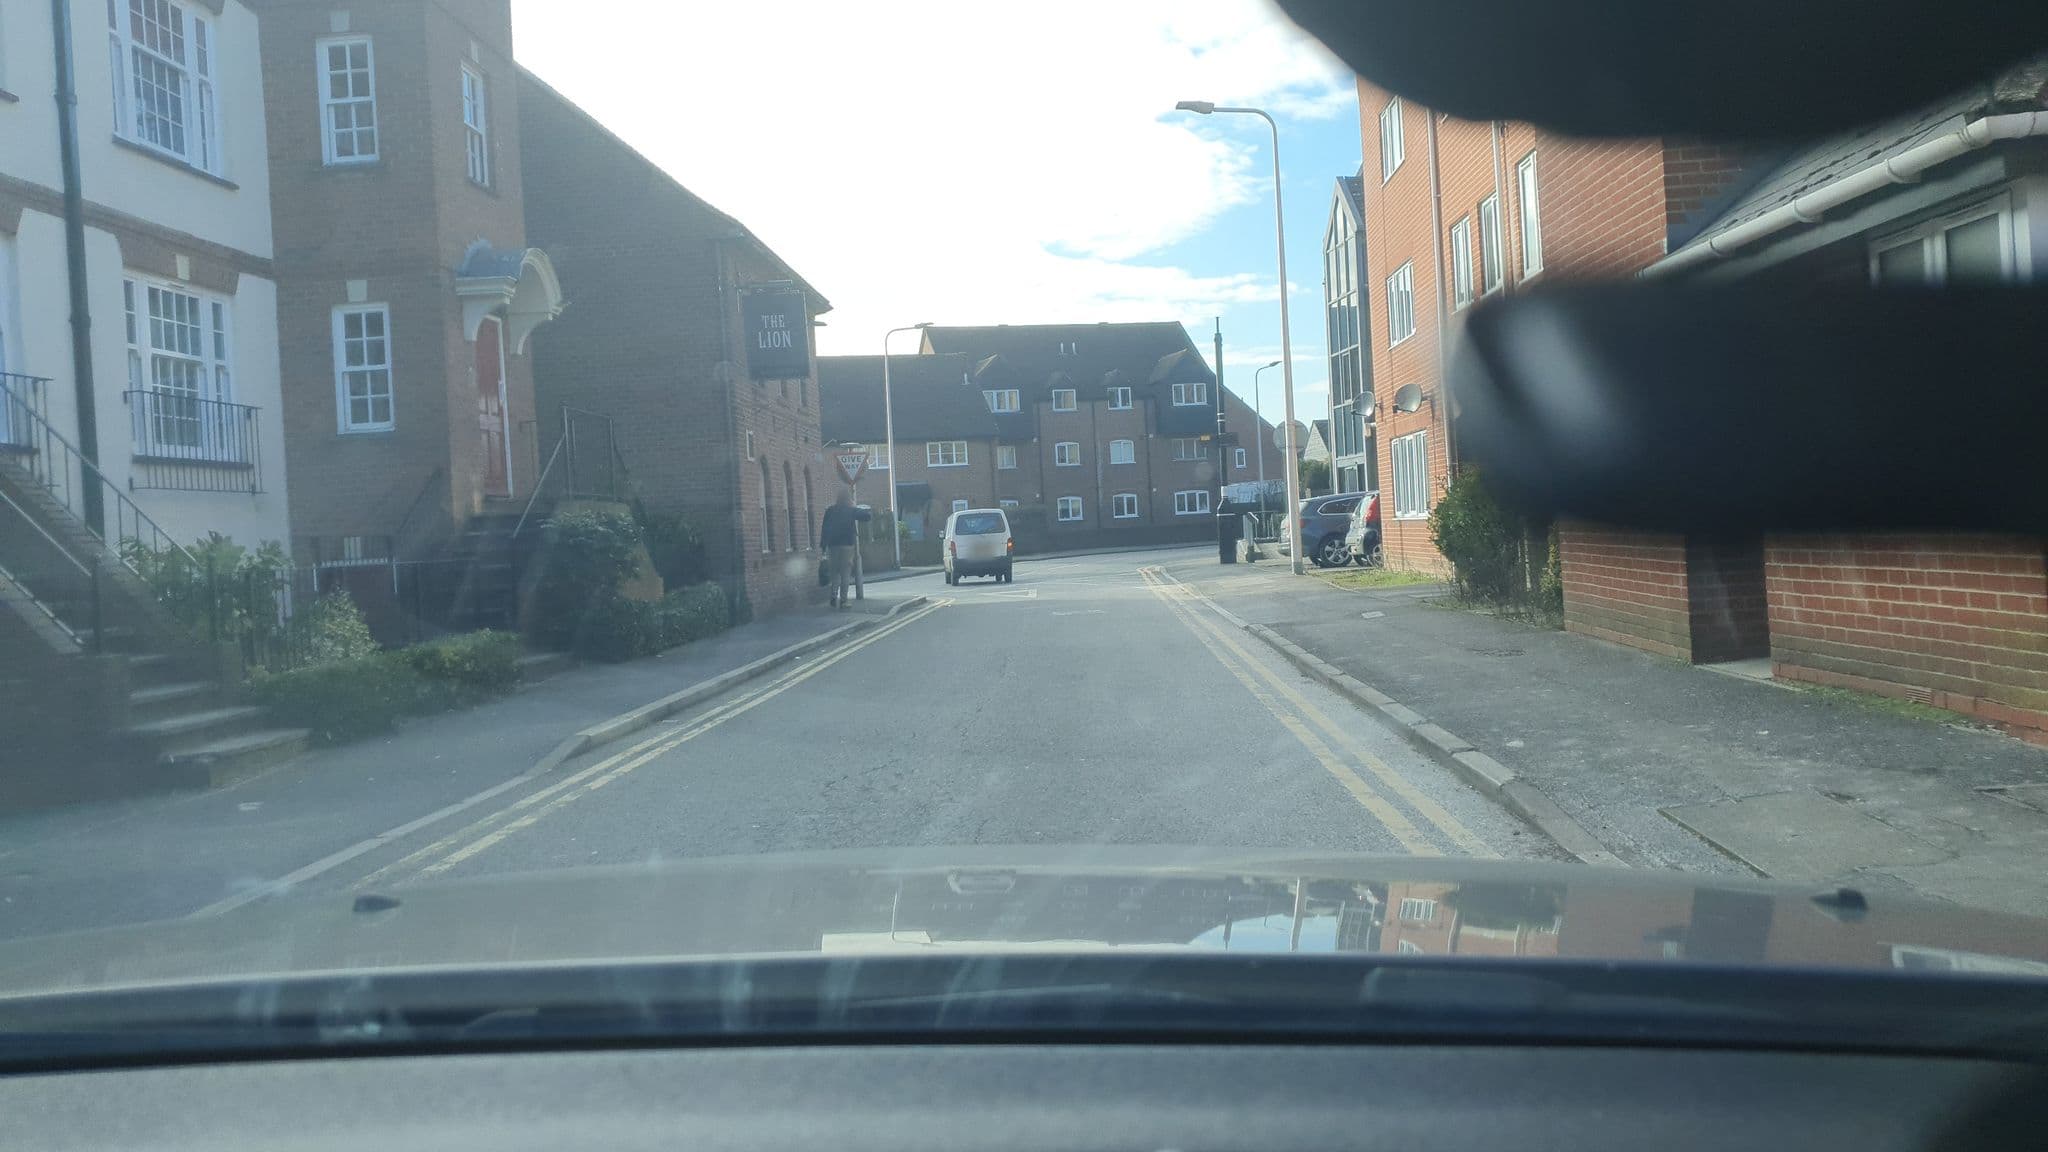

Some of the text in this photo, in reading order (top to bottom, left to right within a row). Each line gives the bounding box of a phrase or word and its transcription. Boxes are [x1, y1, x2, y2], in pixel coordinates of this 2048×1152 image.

[761, 314, 785, 328] THE
[758, 331, 792, 348] LION
[841, 455, 862, 463] GIVE
